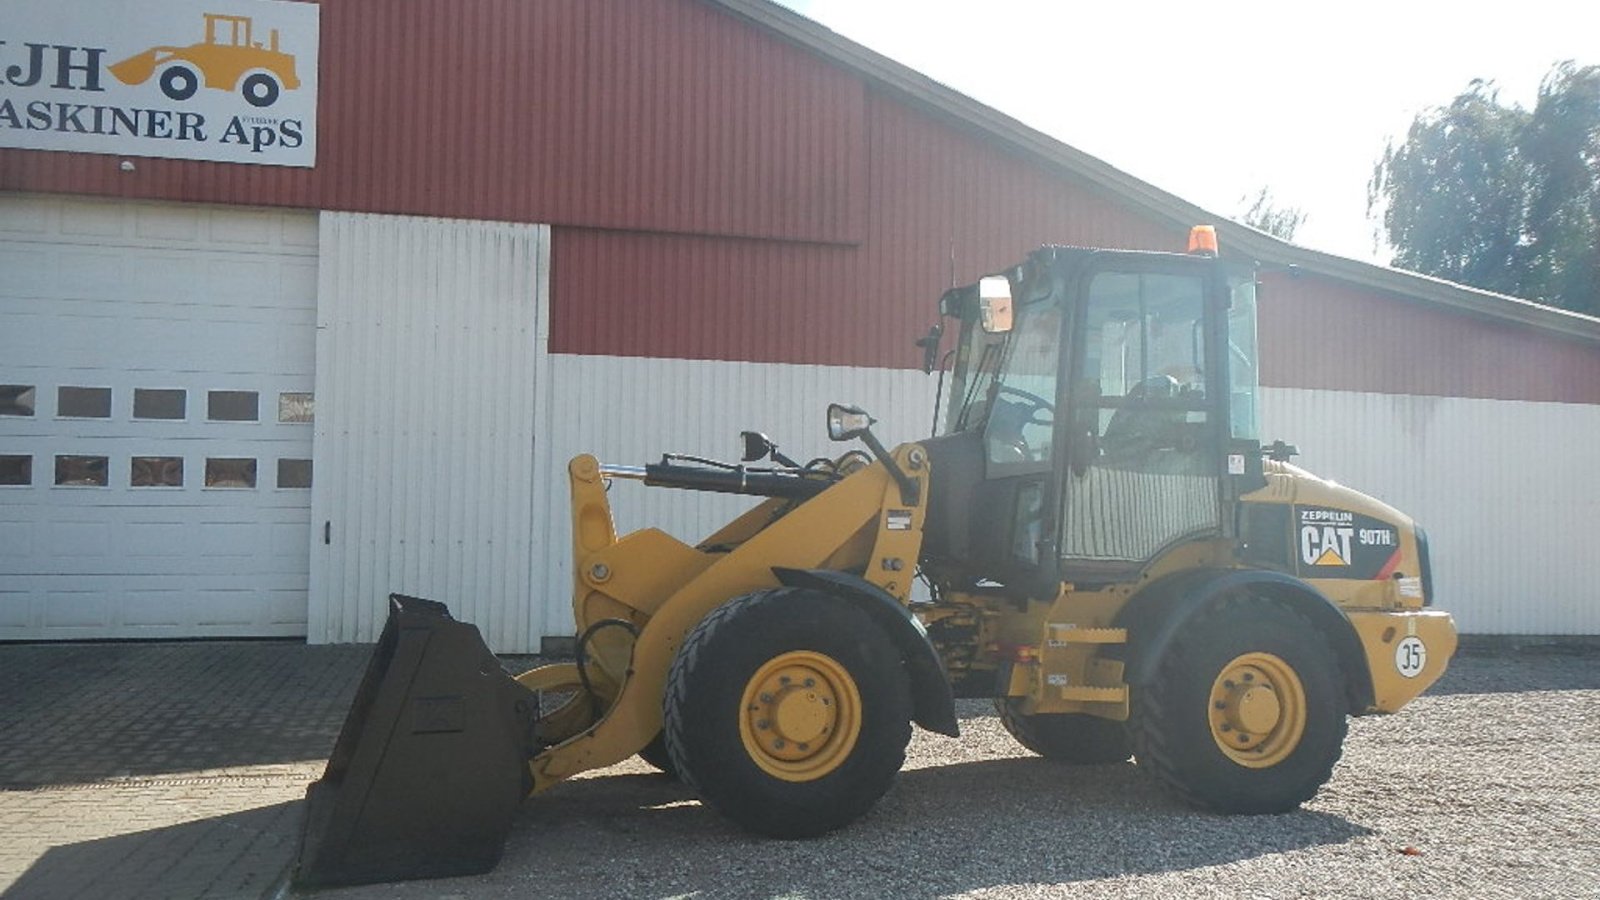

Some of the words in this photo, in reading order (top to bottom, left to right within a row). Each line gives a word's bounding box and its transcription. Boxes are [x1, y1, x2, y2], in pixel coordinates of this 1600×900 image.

[0, 40, 107, 92] JH
[219, 115, 303, 153] ApS
[1301, 510, 1353, 522] ZEPPELIN
[1301, 524, 1354, 566] CAT
[1359, 528, 1391, 545] 907H
[1401, 643, 1420, 670] 35
